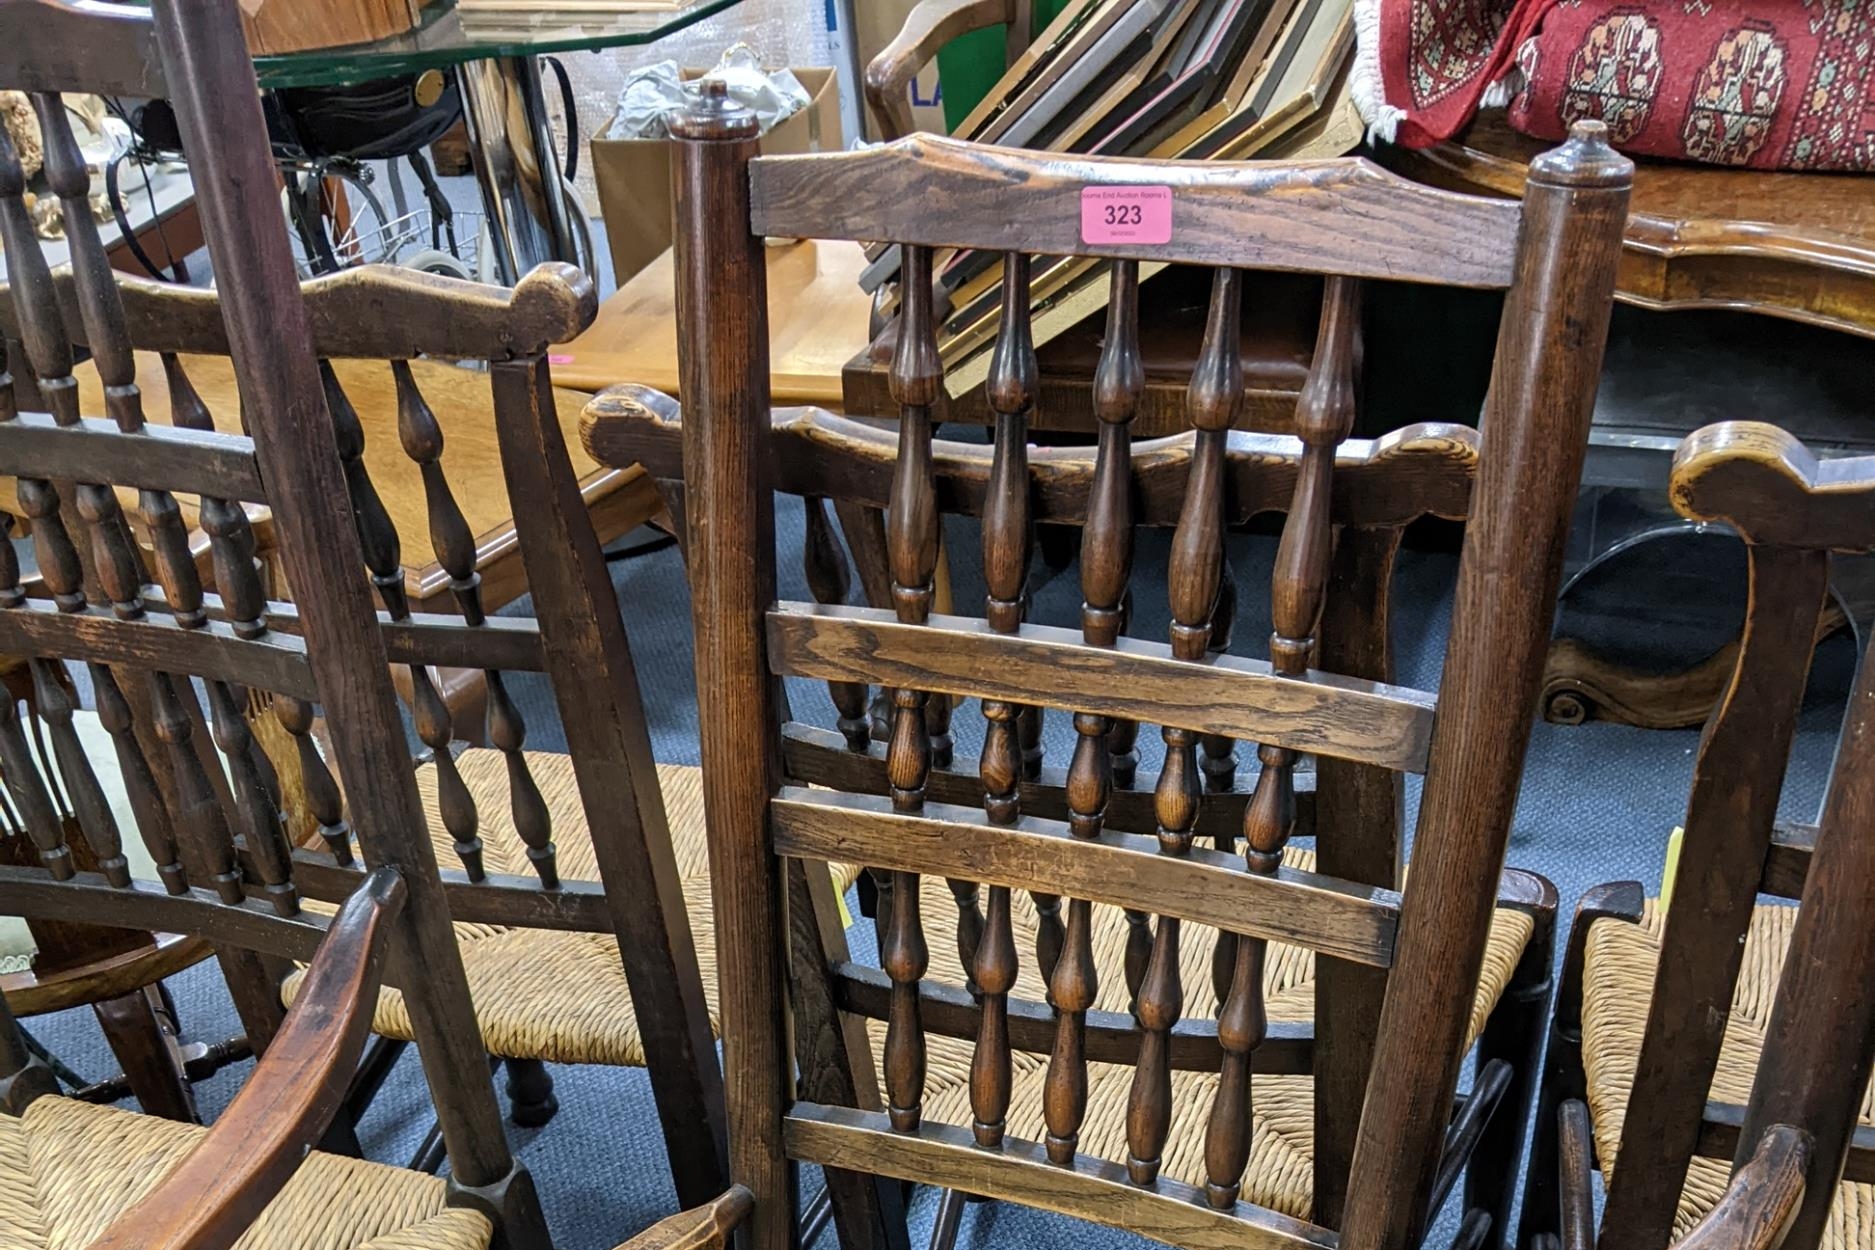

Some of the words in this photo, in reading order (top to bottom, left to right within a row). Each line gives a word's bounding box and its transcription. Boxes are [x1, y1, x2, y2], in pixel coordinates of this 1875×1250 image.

[1102, 191, 1115, 199] End
[1115, 191, 1139, 199] Auction
[1140, 191, 1161, 199] Rooms
[1104, 204, 1142, 225] 323
